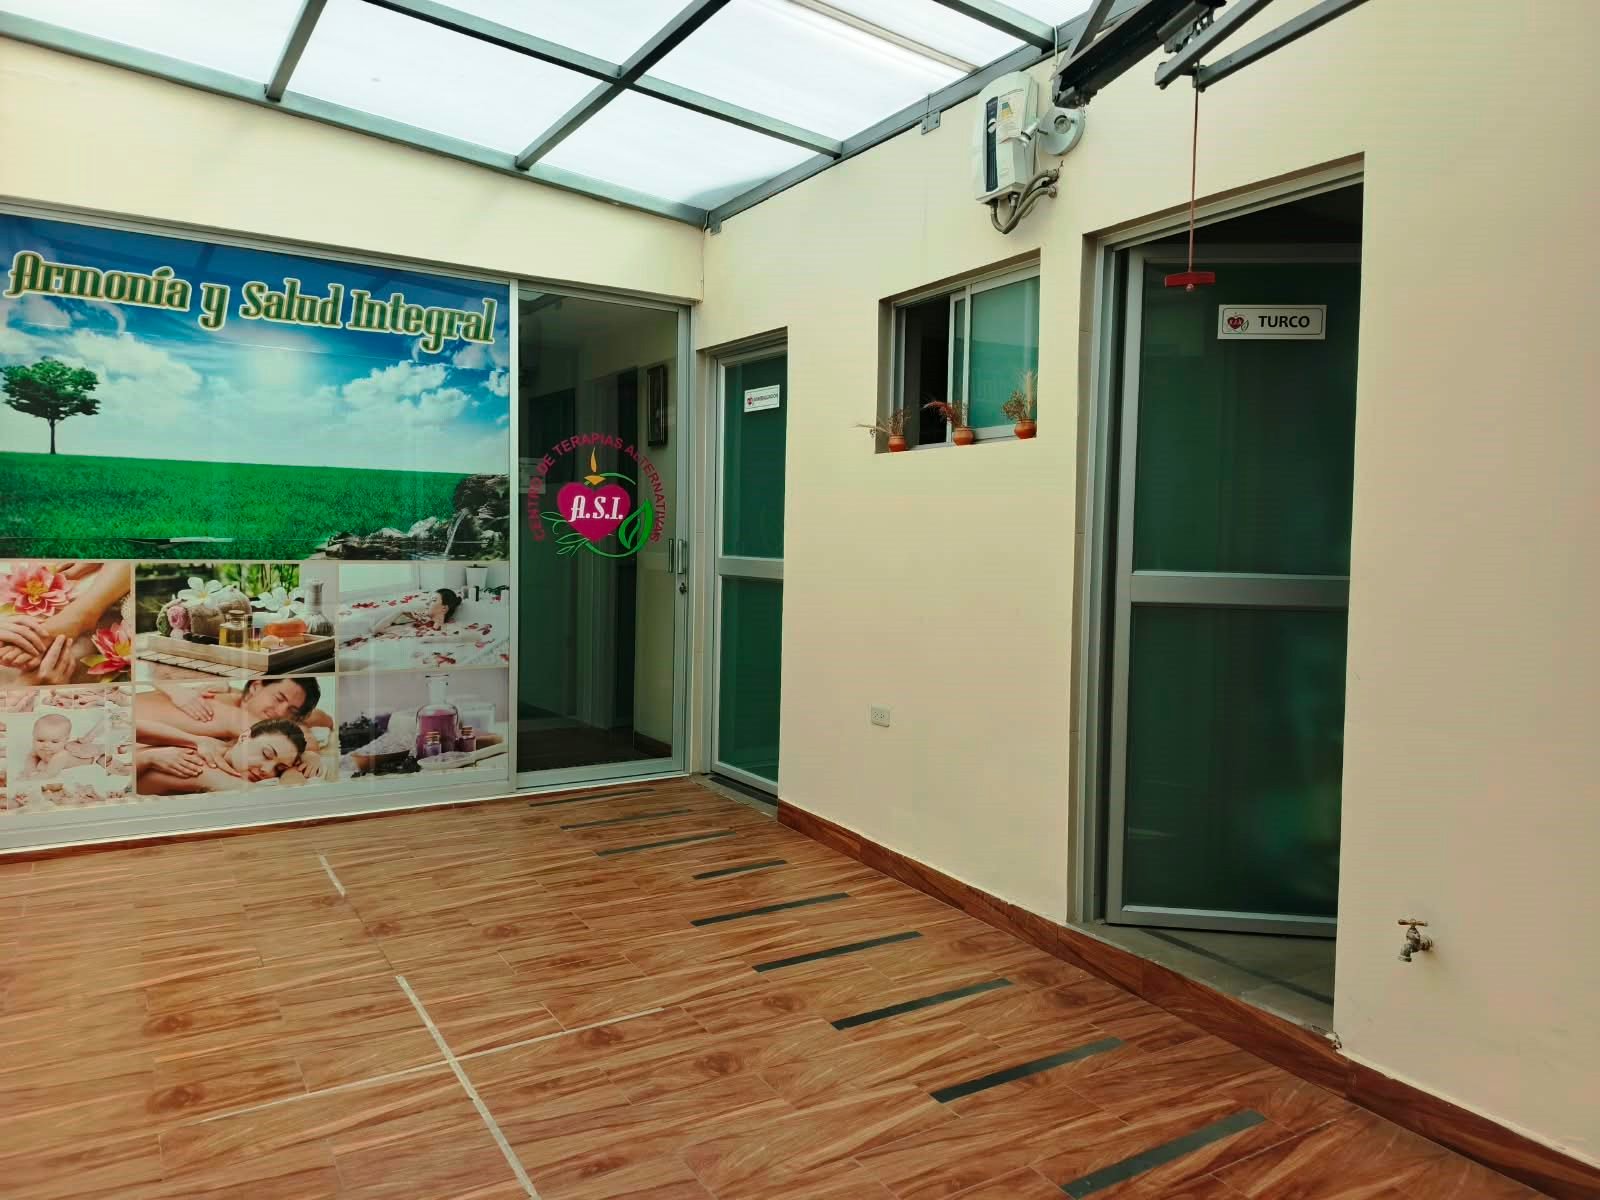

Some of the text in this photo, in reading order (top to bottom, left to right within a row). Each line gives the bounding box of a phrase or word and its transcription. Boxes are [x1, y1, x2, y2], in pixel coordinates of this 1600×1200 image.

[4, 251, 496, 354] Armonía y Salud Integral
[1258, 316, 1310, 328] TURCO
[537, 454, 555, 475] DE
[553, 432, 623, 456] TERAPIAS
[624, 445, 667, 543] ALTERNATIVAS
[568, 495, 624, 522] A.S.I.
